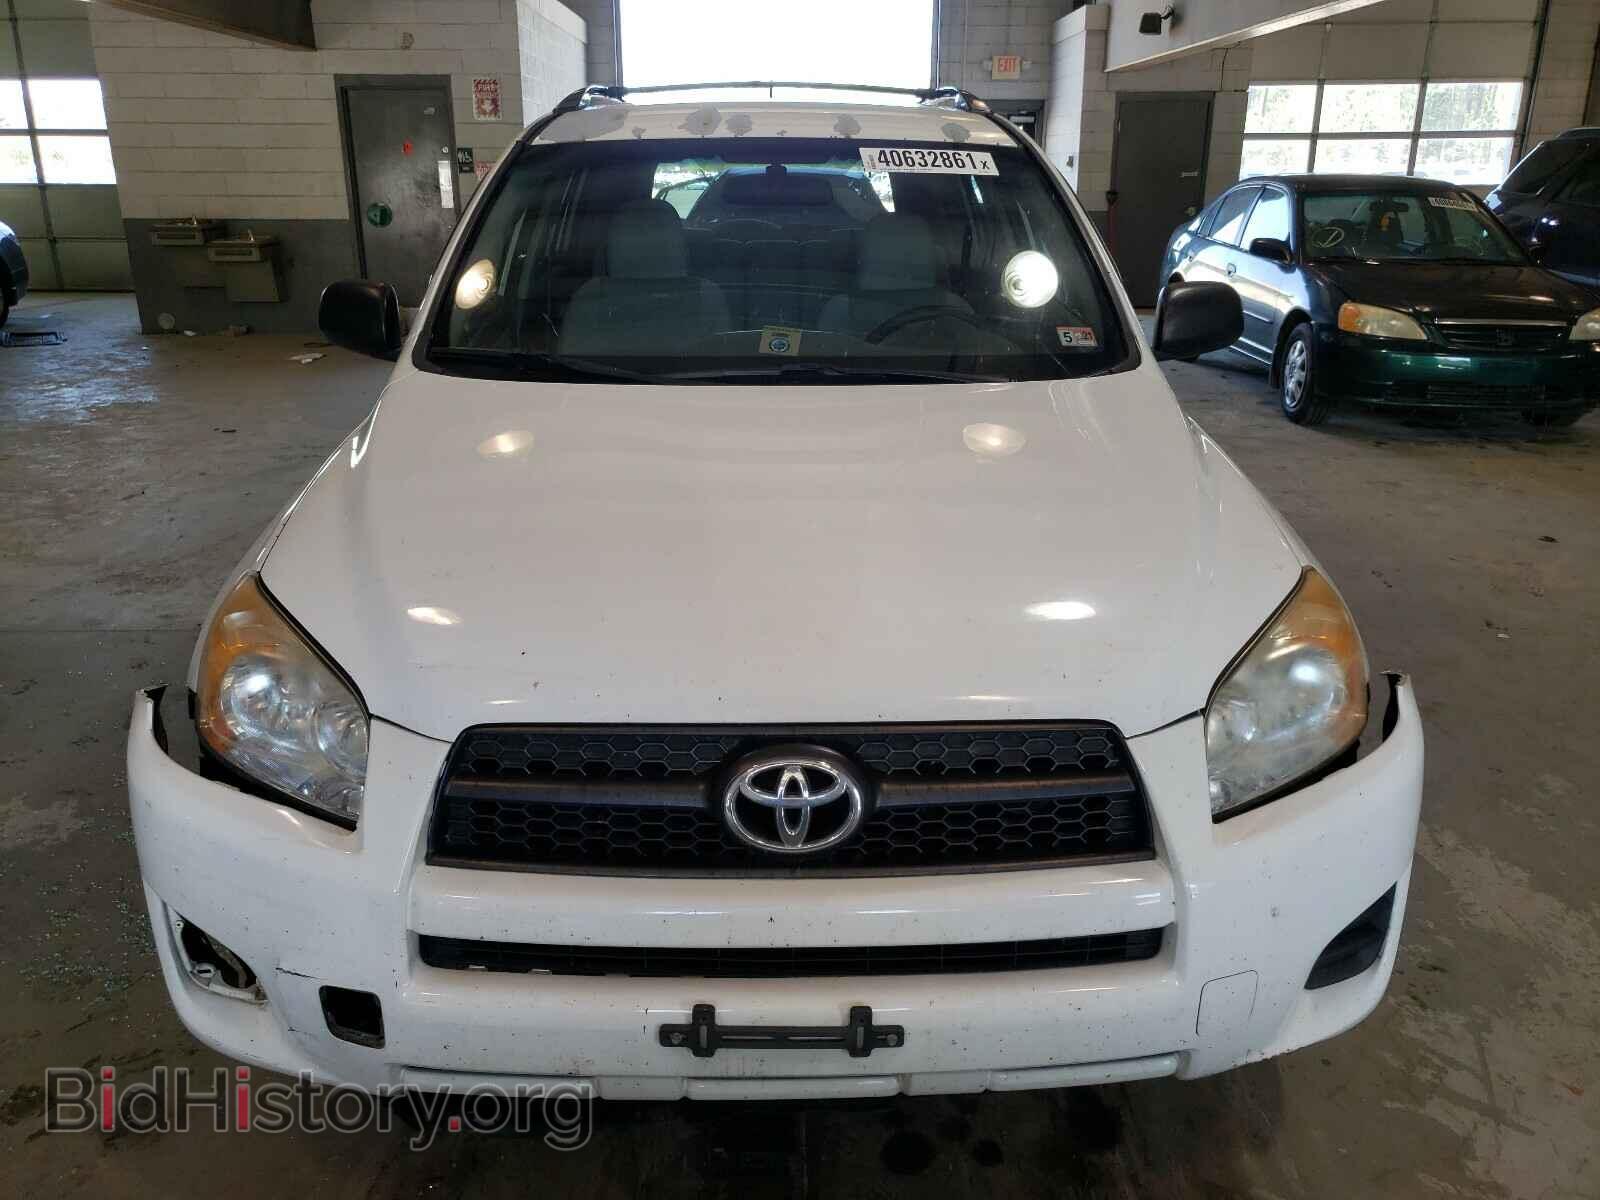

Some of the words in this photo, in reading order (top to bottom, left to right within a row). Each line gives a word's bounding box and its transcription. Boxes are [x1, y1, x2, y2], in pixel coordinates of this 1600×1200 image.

[998, 57, 1017, 72] EXIT
[878, 149, 978, 170] 40632861
[1063, 331, 1073, 343] 5
